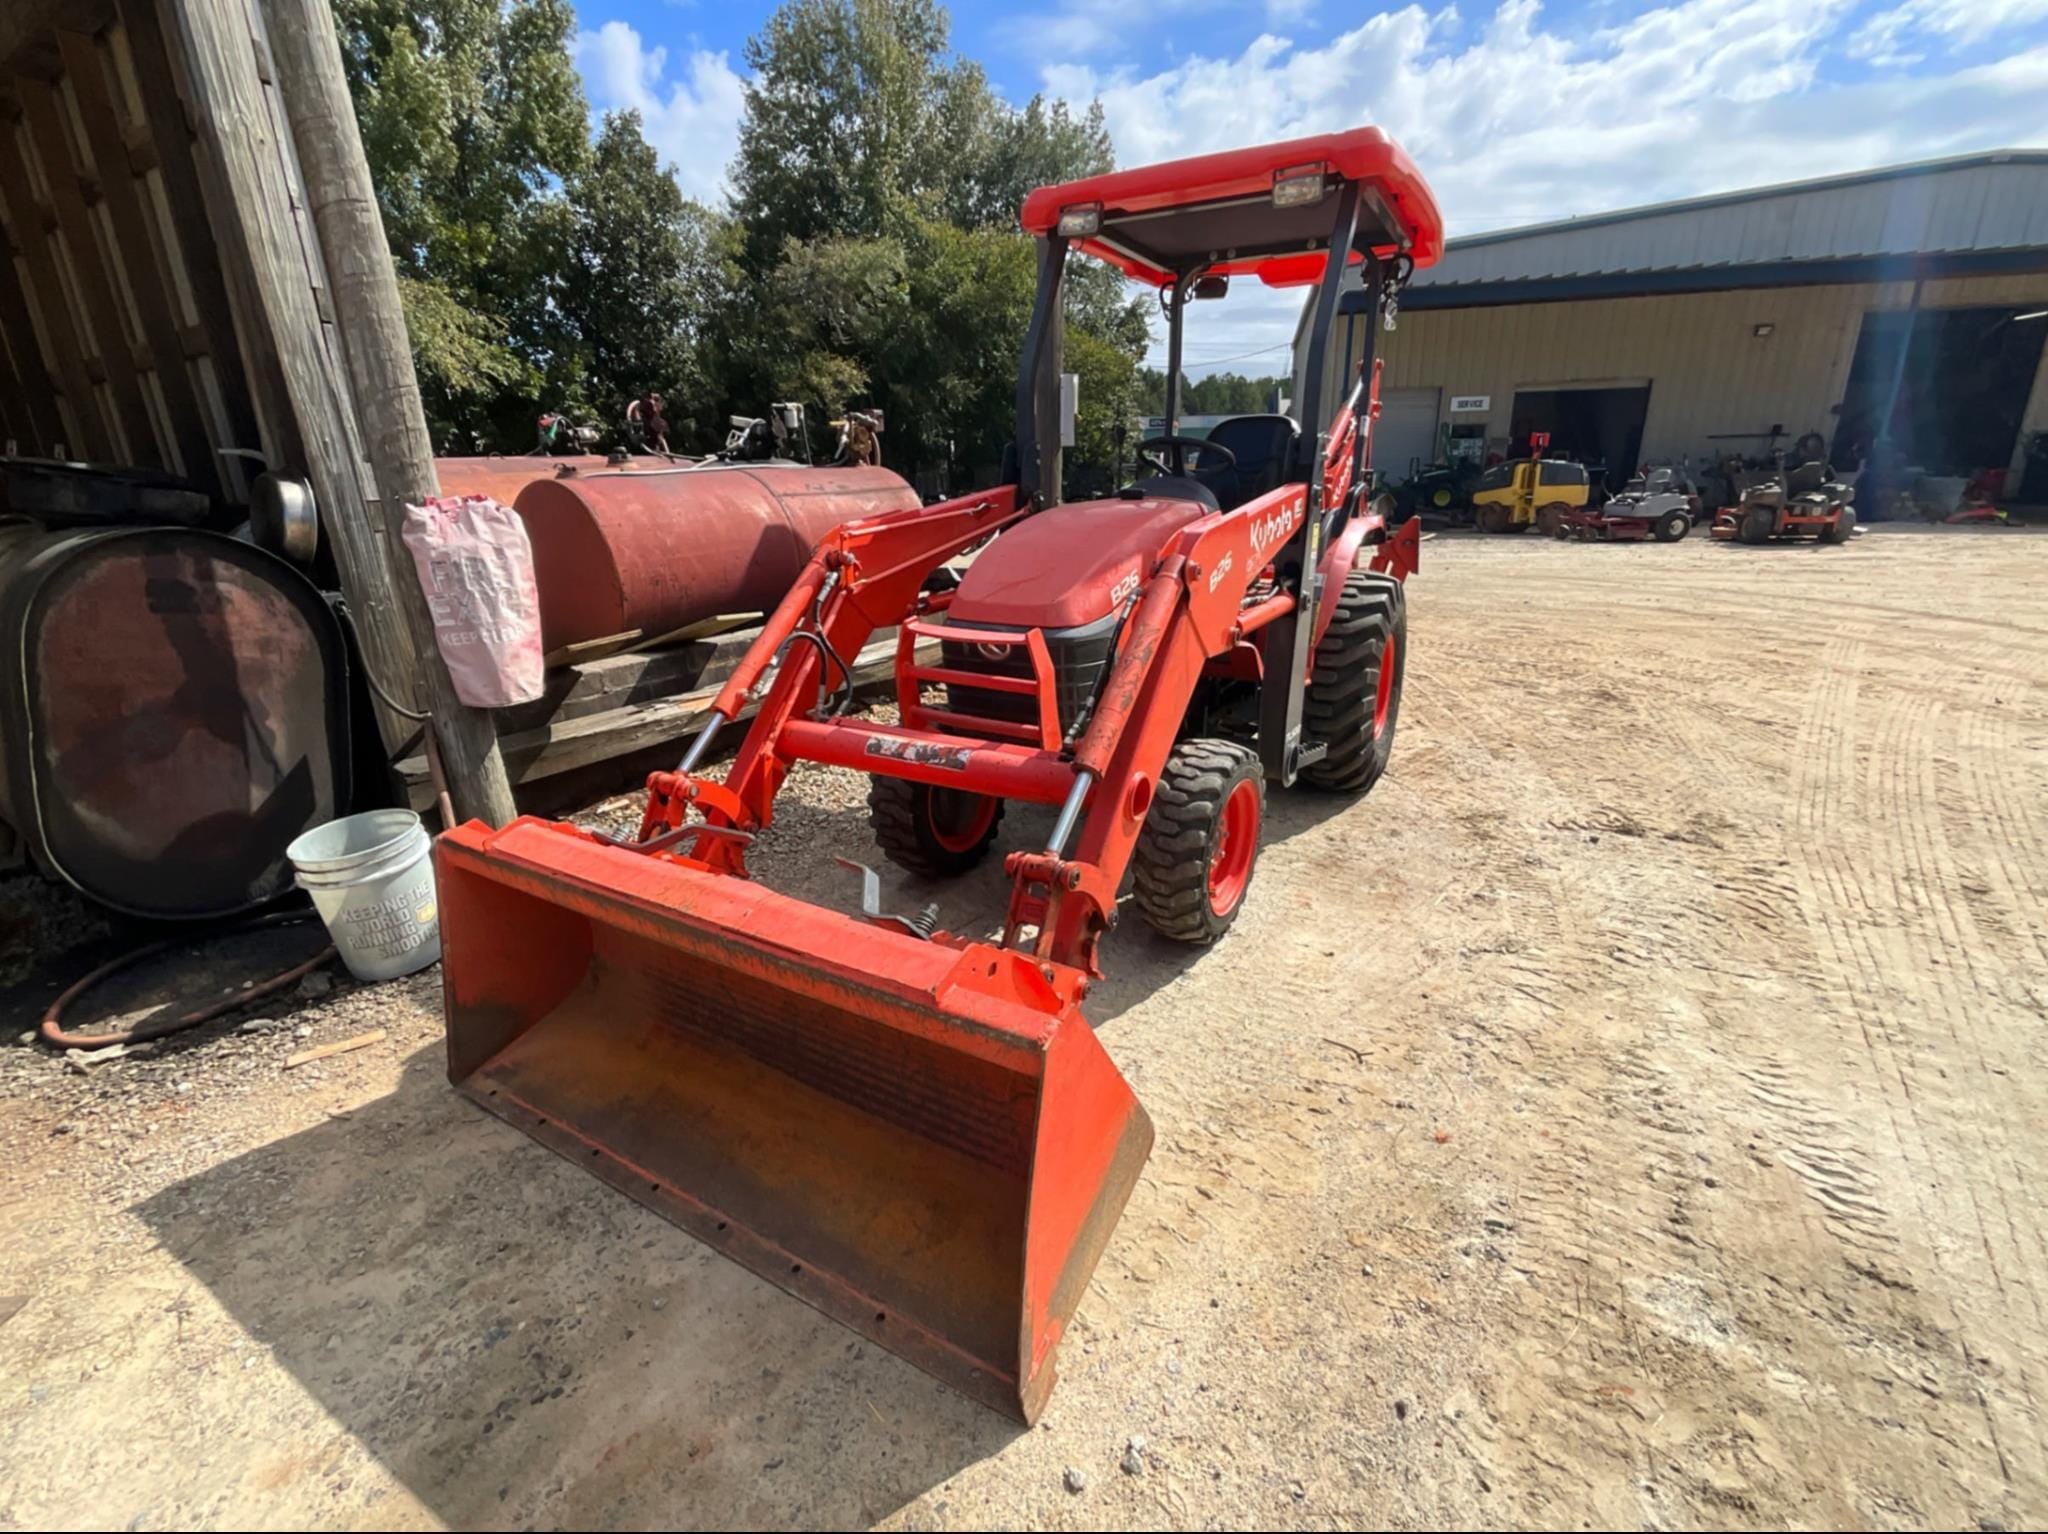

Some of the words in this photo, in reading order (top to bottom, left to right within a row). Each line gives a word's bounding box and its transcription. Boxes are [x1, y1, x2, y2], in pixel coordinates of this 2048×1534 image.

[1250, 504, 1292, 553] Kubota
[1110, 569, 1139, 607] B26
[1209, 551, 1232, 593] B26
[342, 894, 408, 922] KEEPING
[408, 880, 430, 901] THE
[357, 908, 411, 933] WORLD
[347, 922, 416, 949] RUNNING
